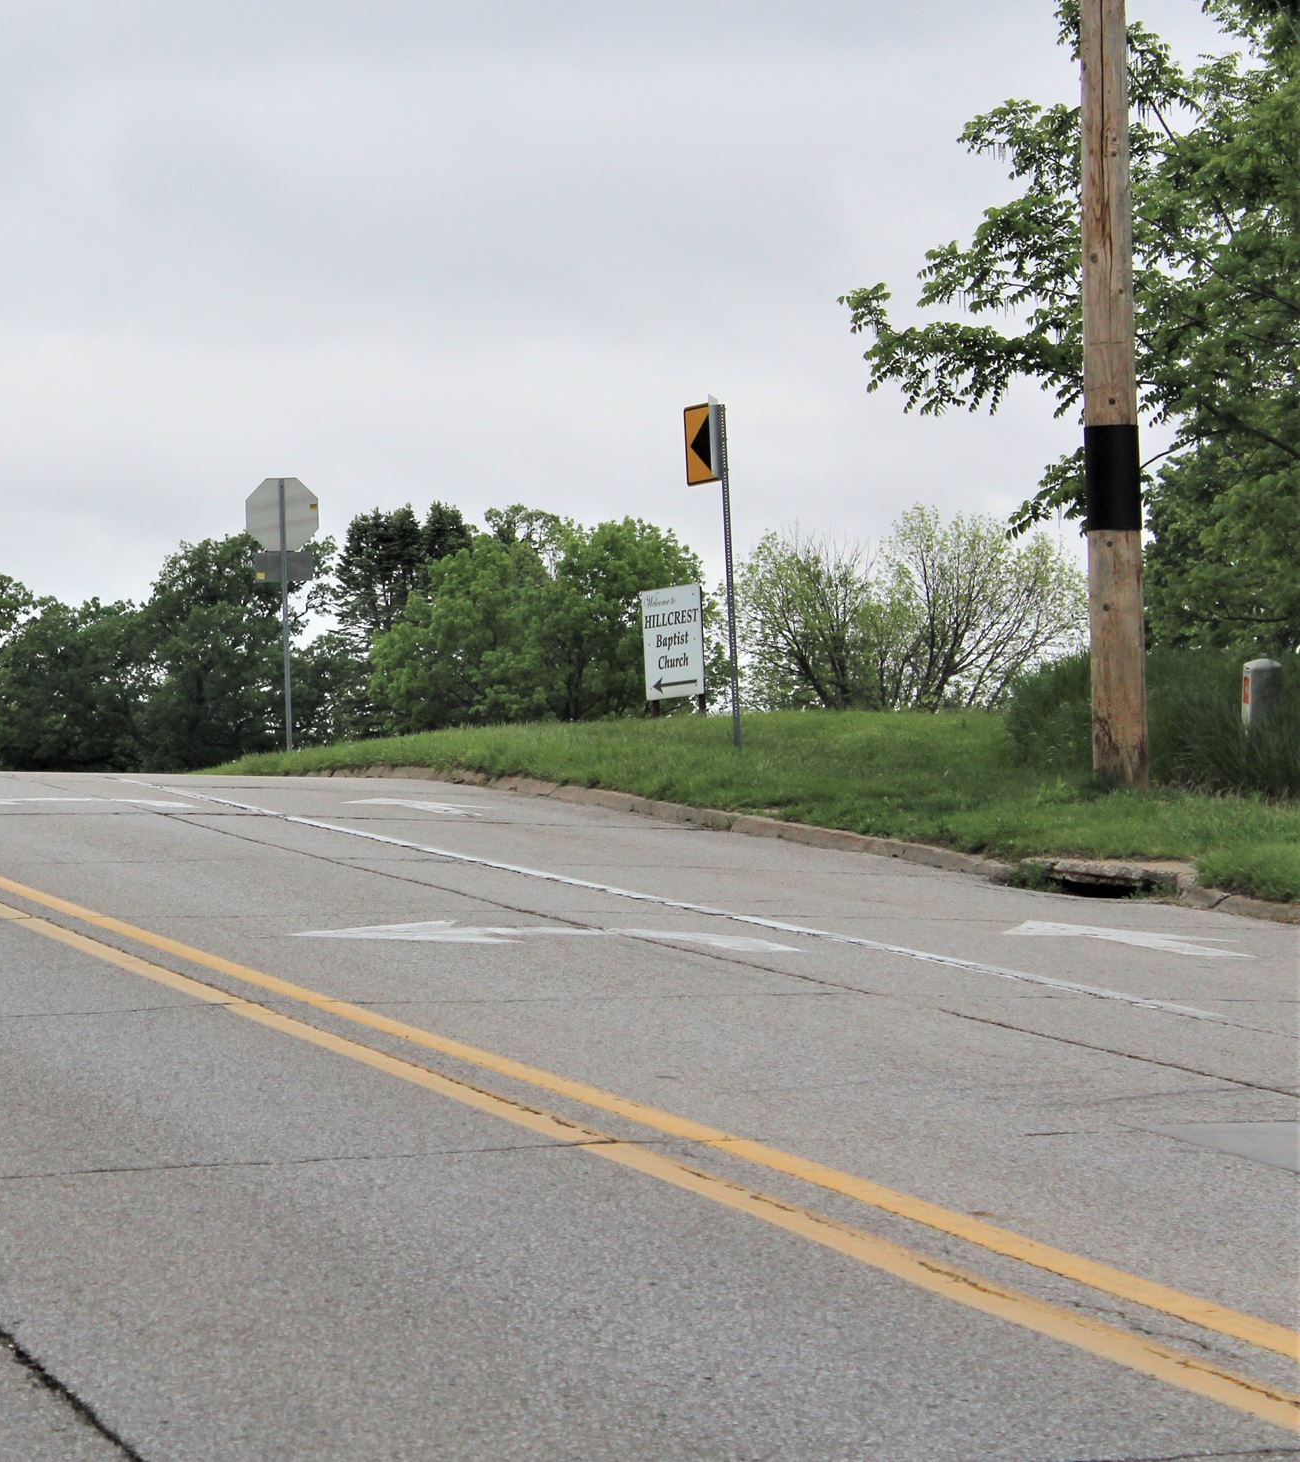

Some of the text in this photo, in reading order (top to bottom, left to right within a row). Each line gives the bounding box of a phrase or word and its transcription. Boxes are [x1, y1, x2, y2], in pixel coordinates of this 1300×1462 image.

[644, 592, 669, 608] Welcome
[644, 608, 699, 629] HILLCREST
[656, 631, 689, 651] Baptist
[658, 652, 689, 670] Church
